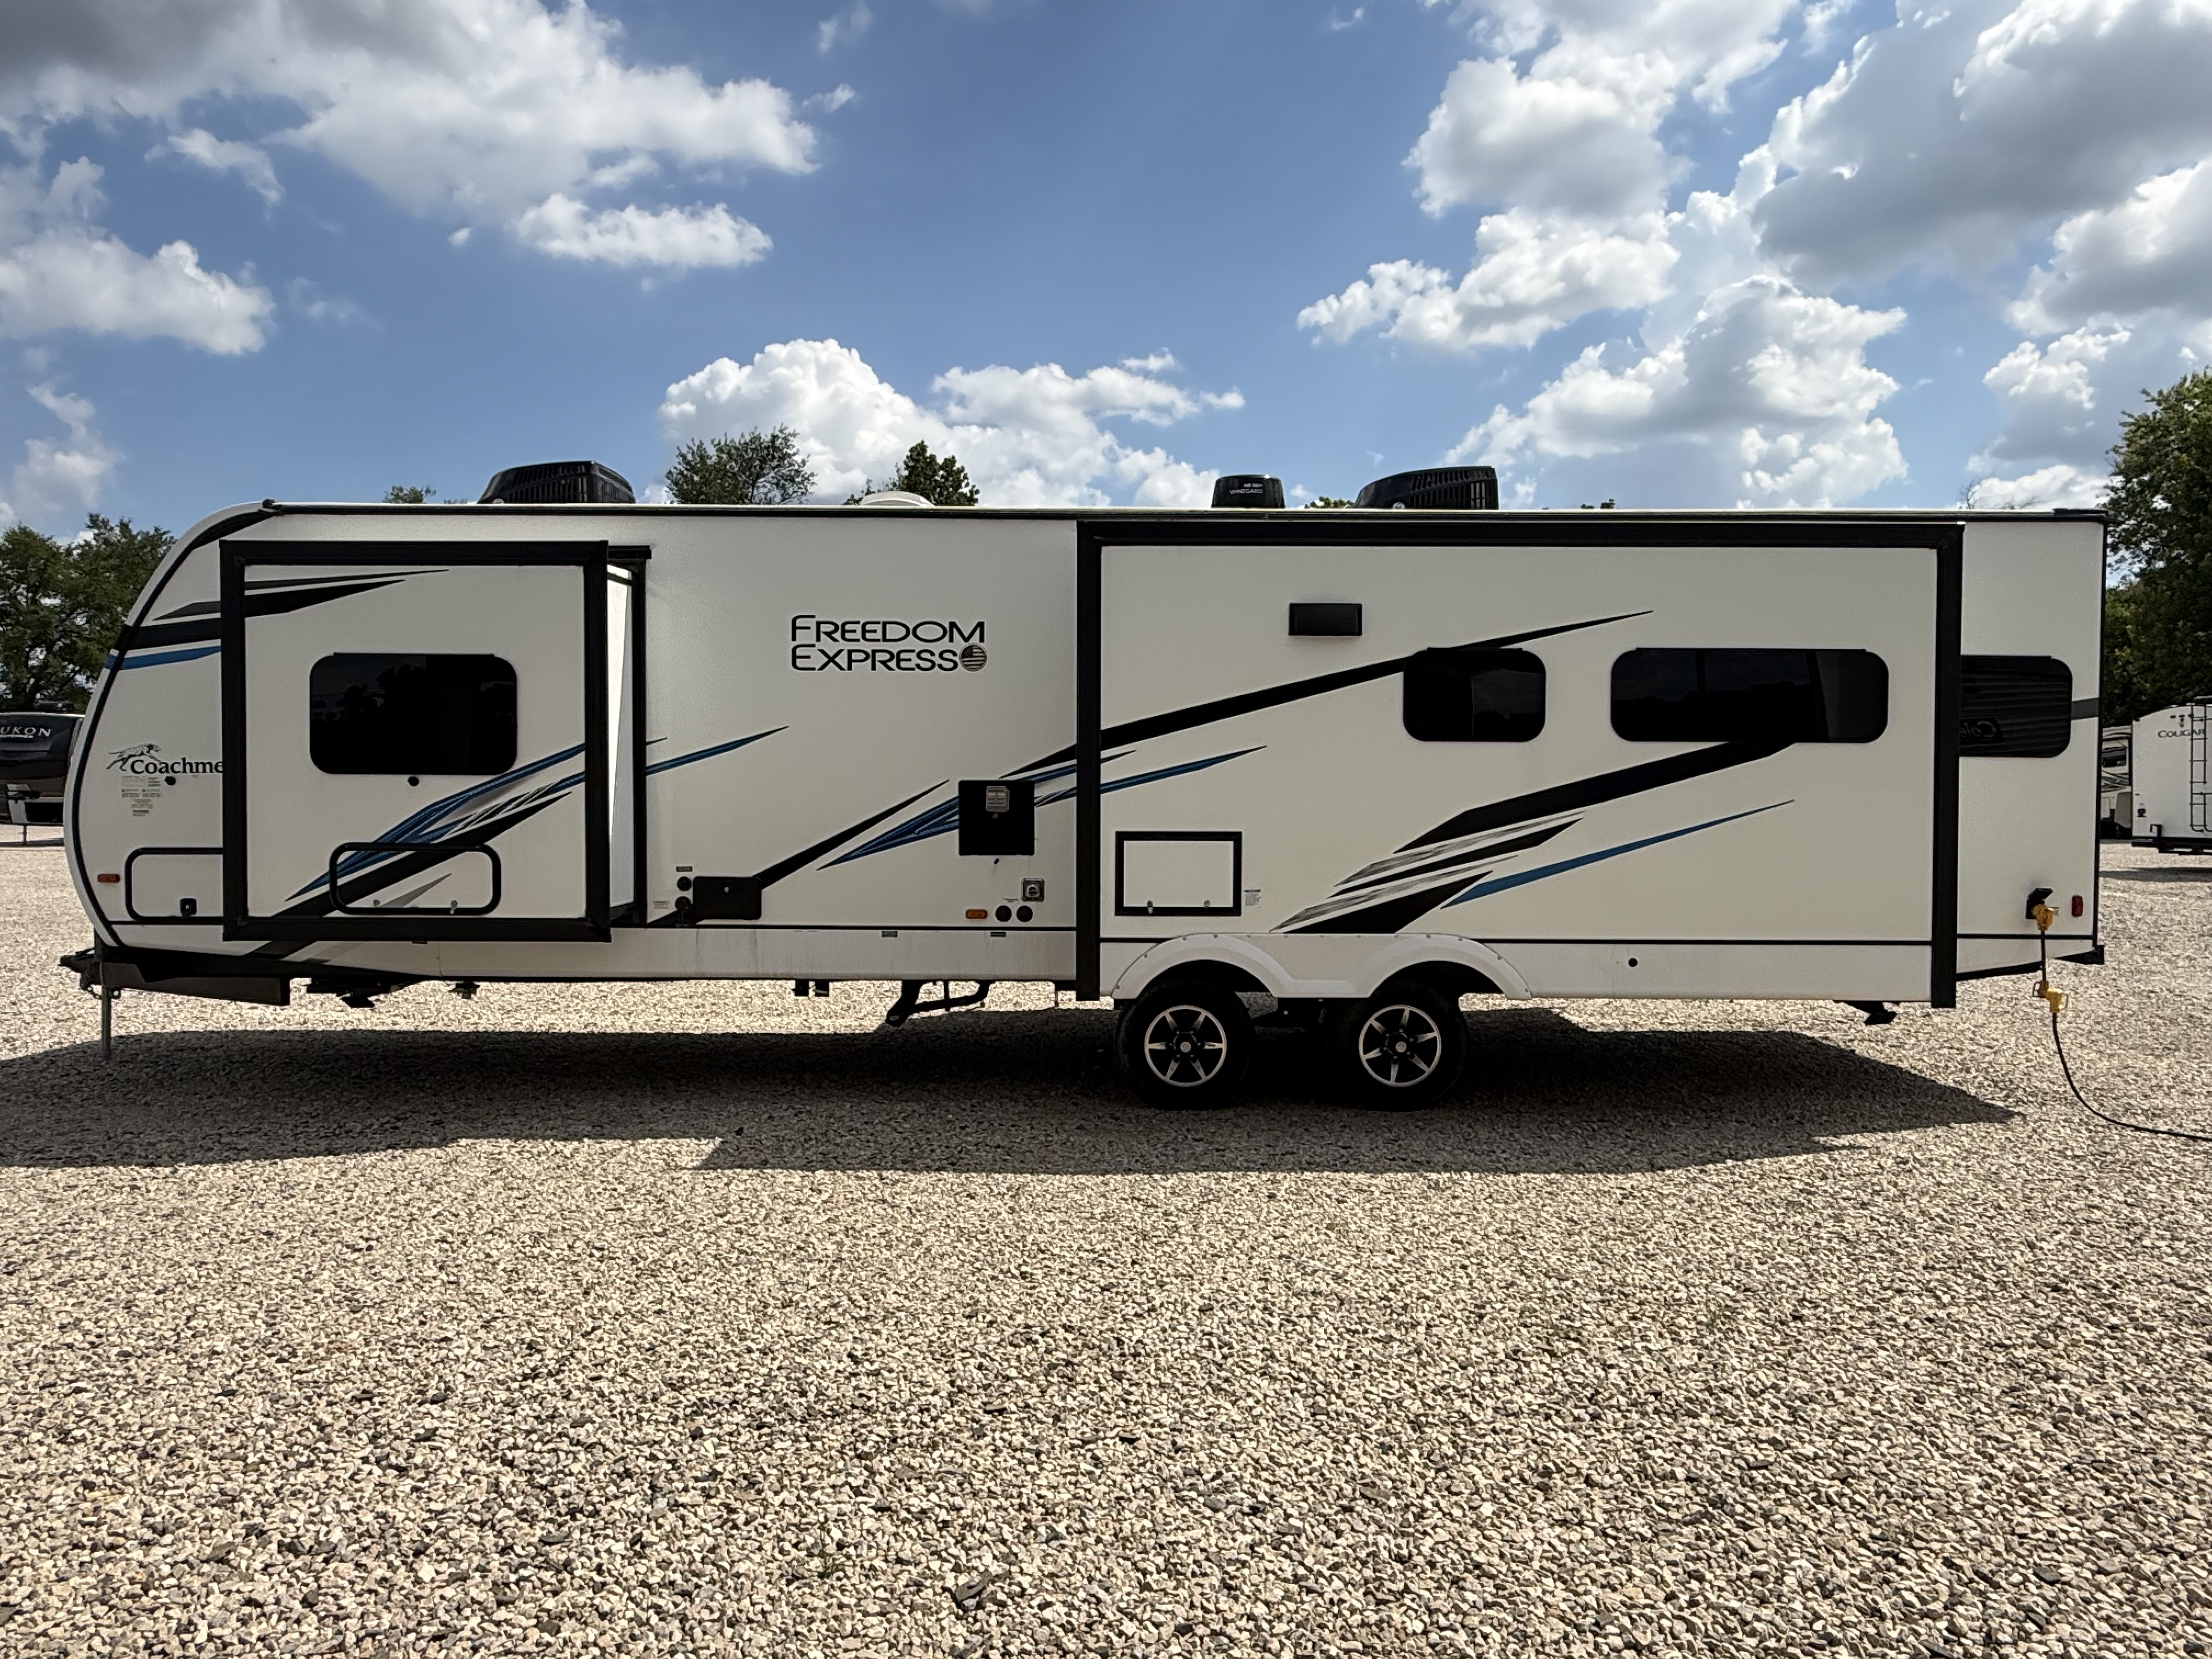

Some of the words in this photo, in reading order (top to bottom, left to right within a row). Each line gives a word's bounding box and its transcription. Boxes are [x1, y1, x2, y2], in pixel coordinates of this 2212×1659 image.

[791, 614, 985, 643] FREEDOM
[791, 644, 958, 671] EXPRESS
[131, 757, 223, 774] Coachme
